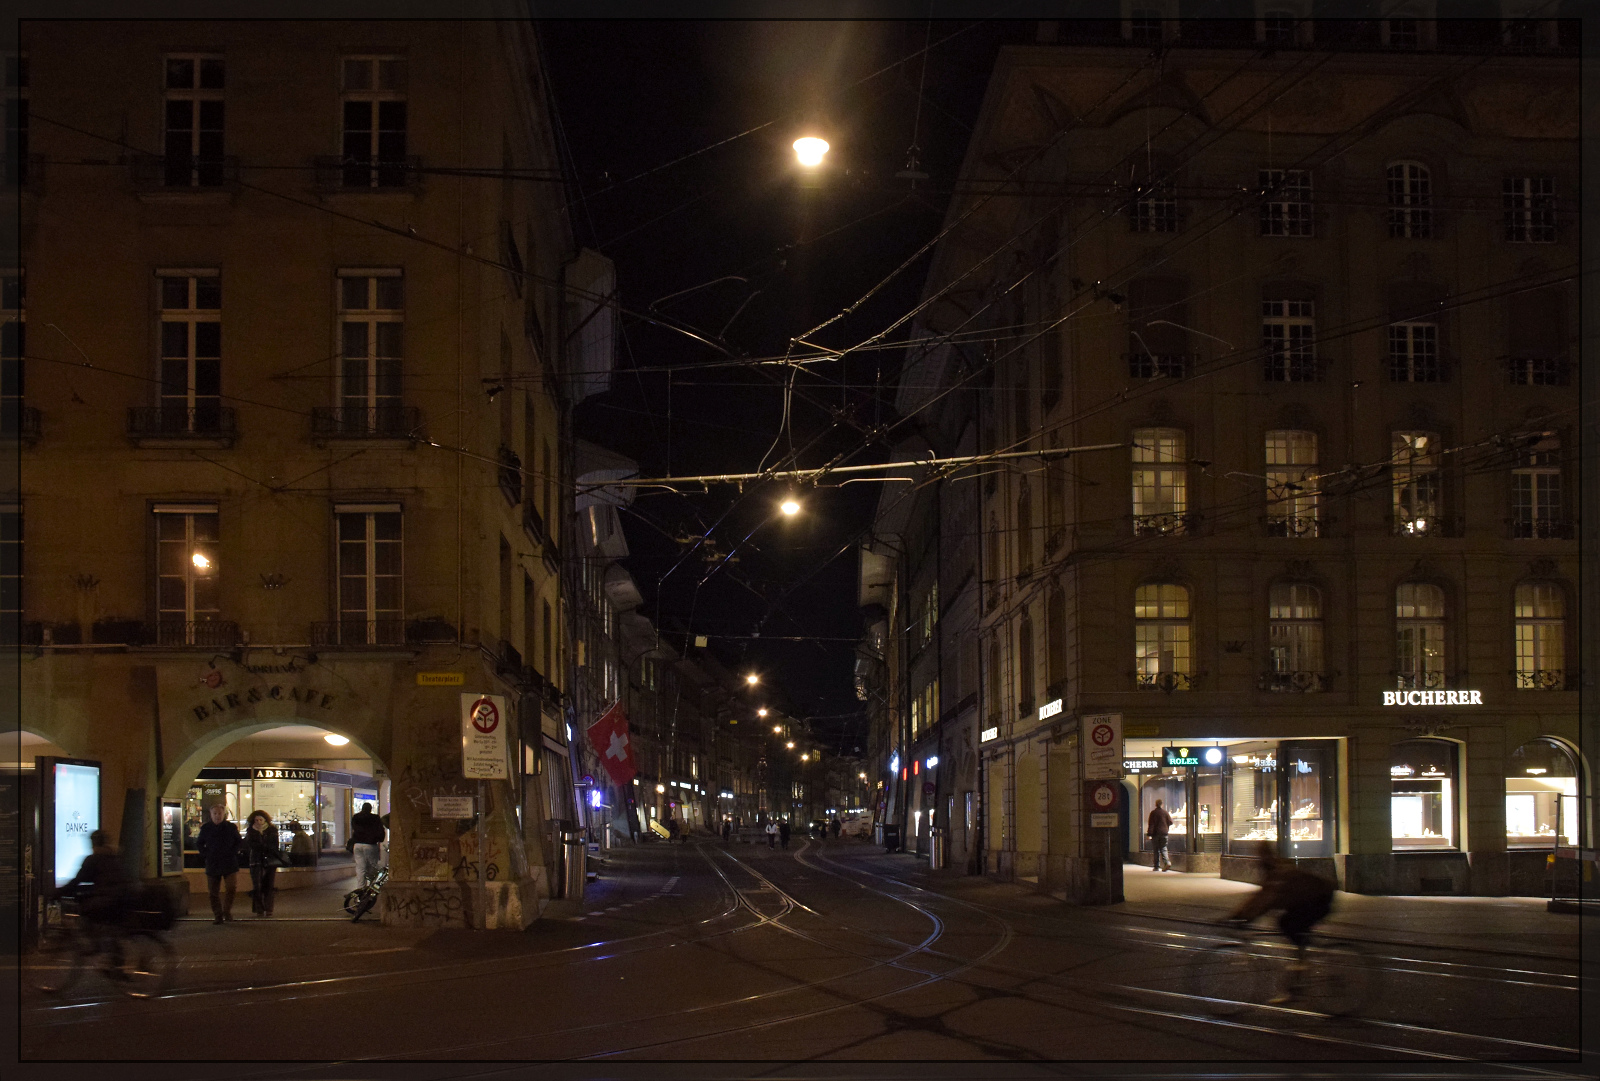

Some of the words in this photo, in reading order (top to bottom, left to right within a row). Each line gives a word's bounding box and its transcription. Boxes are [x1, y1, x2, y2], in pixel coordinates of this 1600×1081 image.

[421, 674, 460, 684] Theaterplatz
[1382, 690, 1483, 706] BUCHERER
[193, 693, 241, 721] BAR
[247, 686, 261, 703] &
[1092, 716, 1112, 725] ZONE
[1169, 757, 1199, 765] ROLEX
[256, 769, 315, 779] ADRIANOS
[66, 822, 88, 832] DANKE
